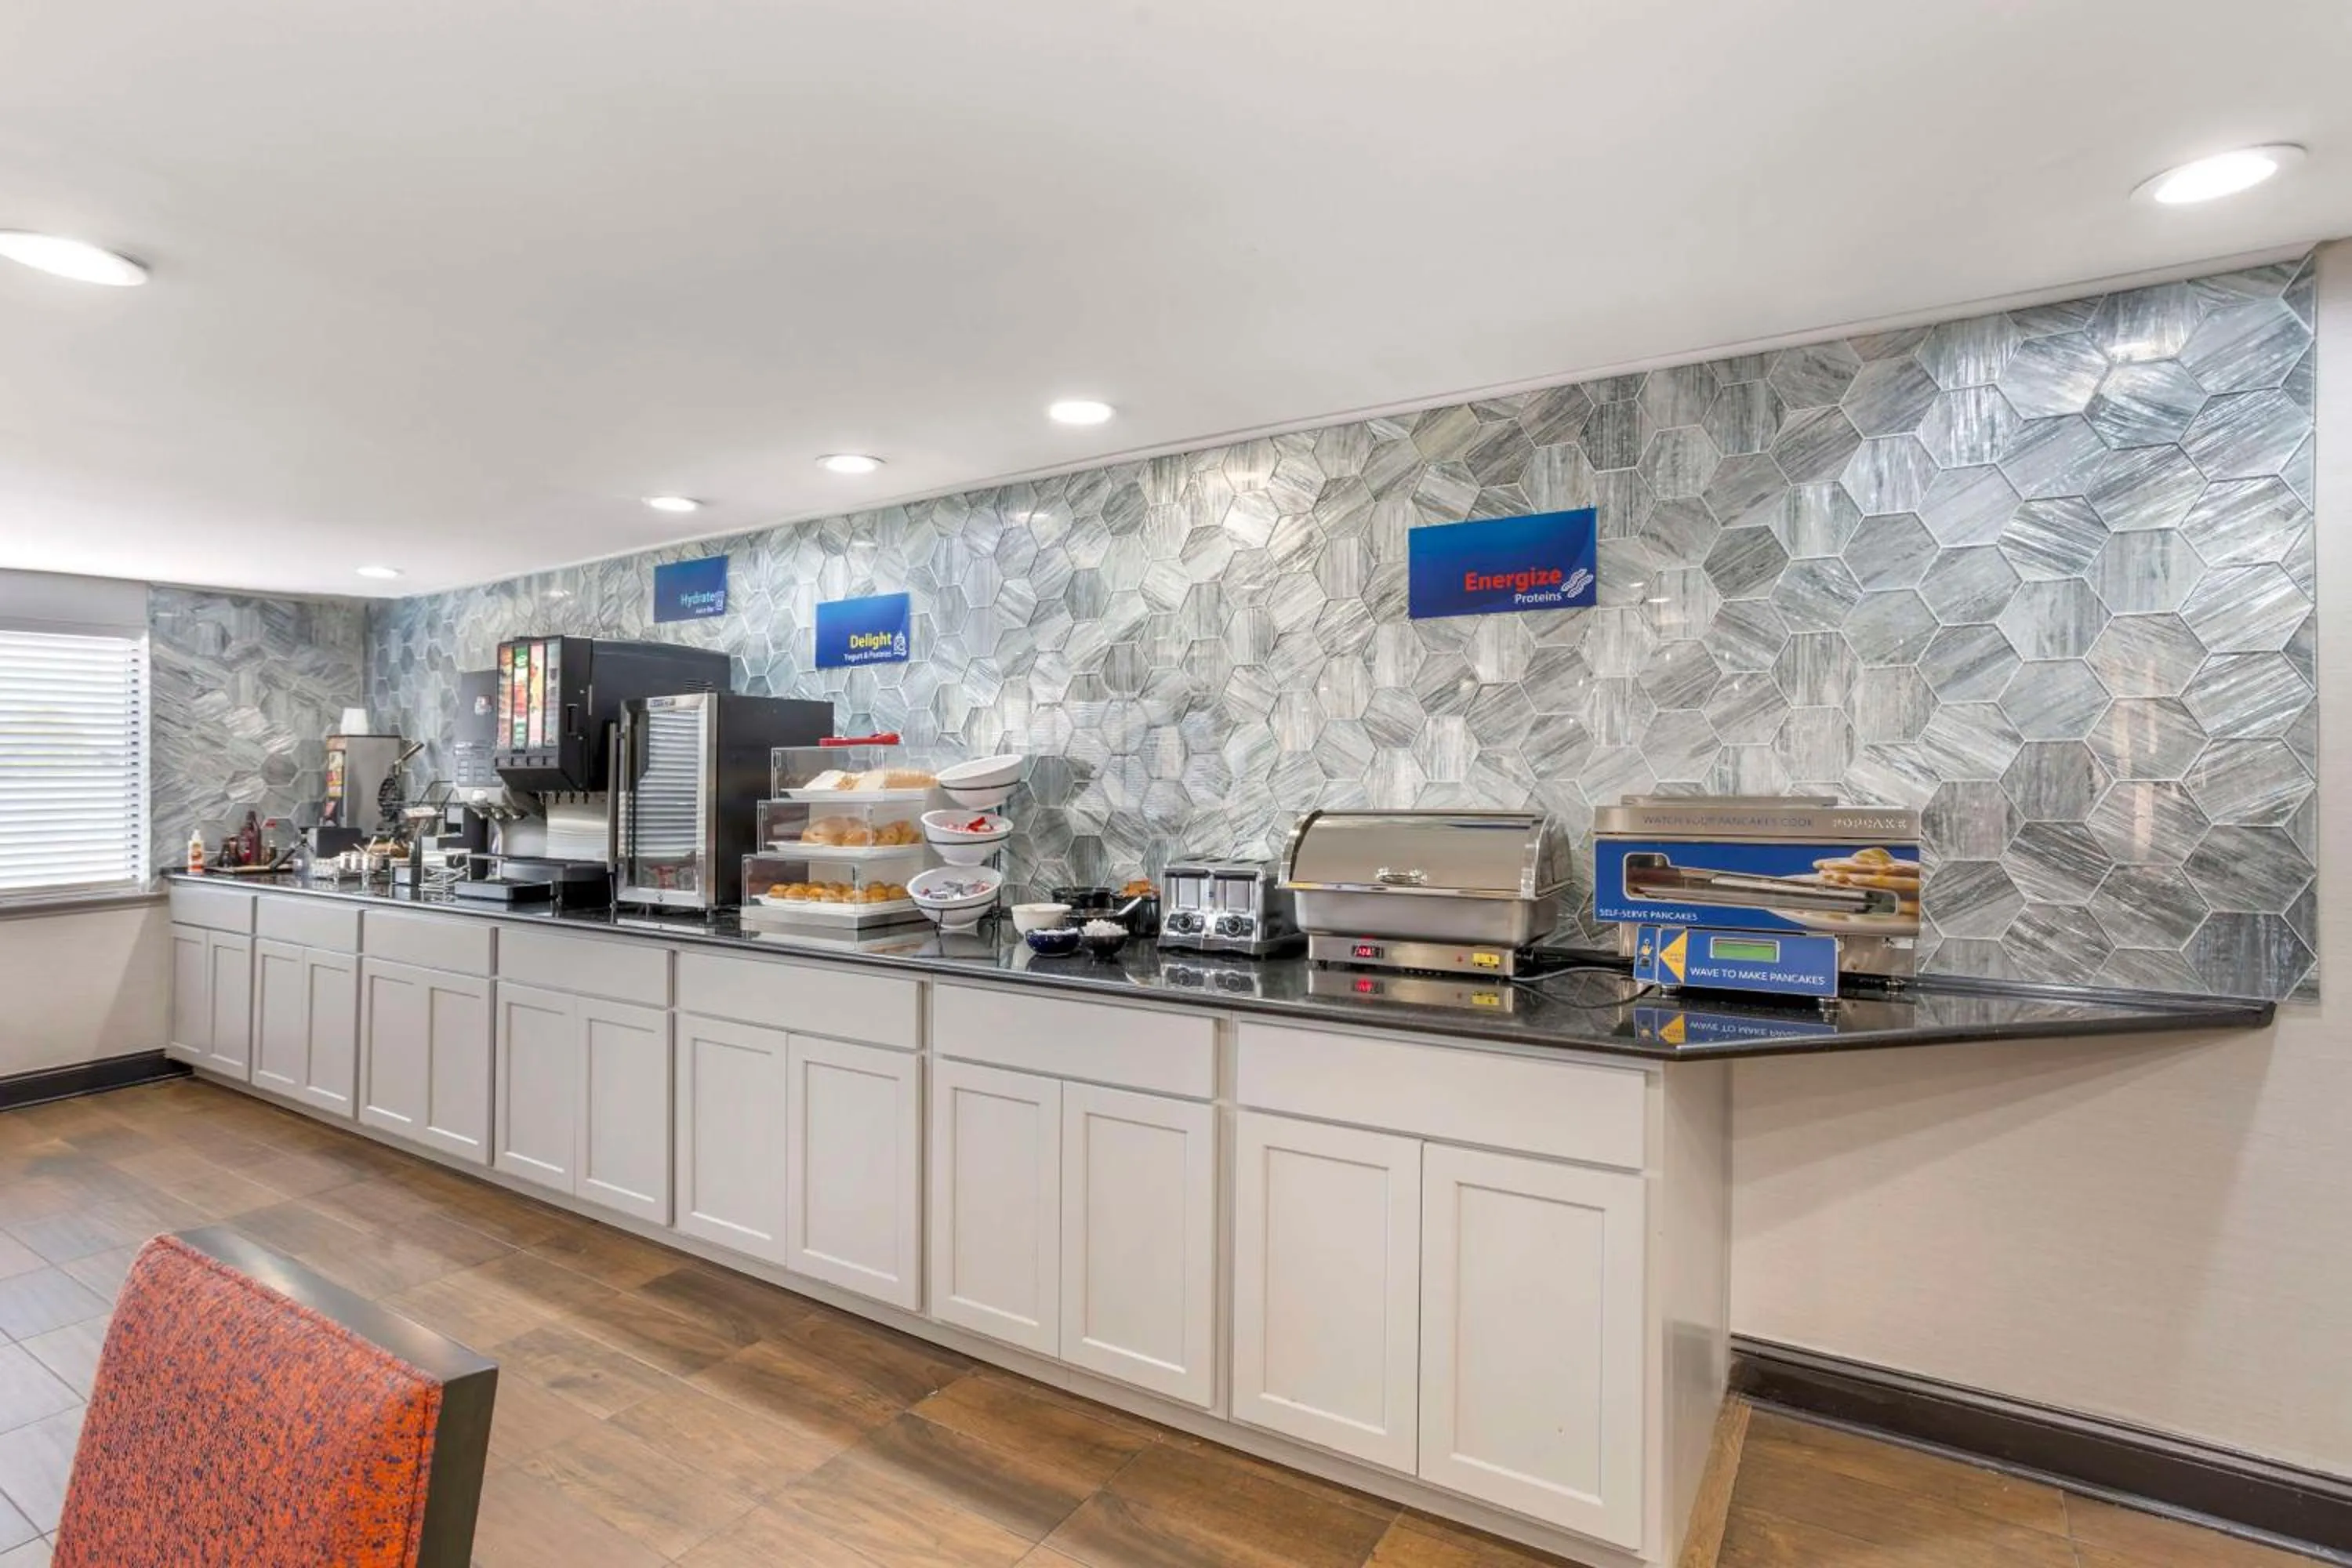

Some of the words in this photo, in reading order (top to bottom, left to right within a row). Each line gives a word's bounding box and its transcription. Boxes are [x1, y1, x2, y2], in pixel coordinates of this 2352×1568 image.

[1465, 568, 1563, 593] Energize
[1515, 590, 1563, 604] Proteins
[850, 632, 892, 650] Delight
[1643, 815, 1682, 825] WATCH
[1599, 909, 1649, 919] SELF-SERVE
[1650, 911, 1698, 921] PANCAKES
[1690, 967, 1719, 978] WAVE
[1722, 968, 1737, 978] TO
[1738, 970, 1767, 981] MAKE
[1769, 973, 1826, 985] PANCAKES
